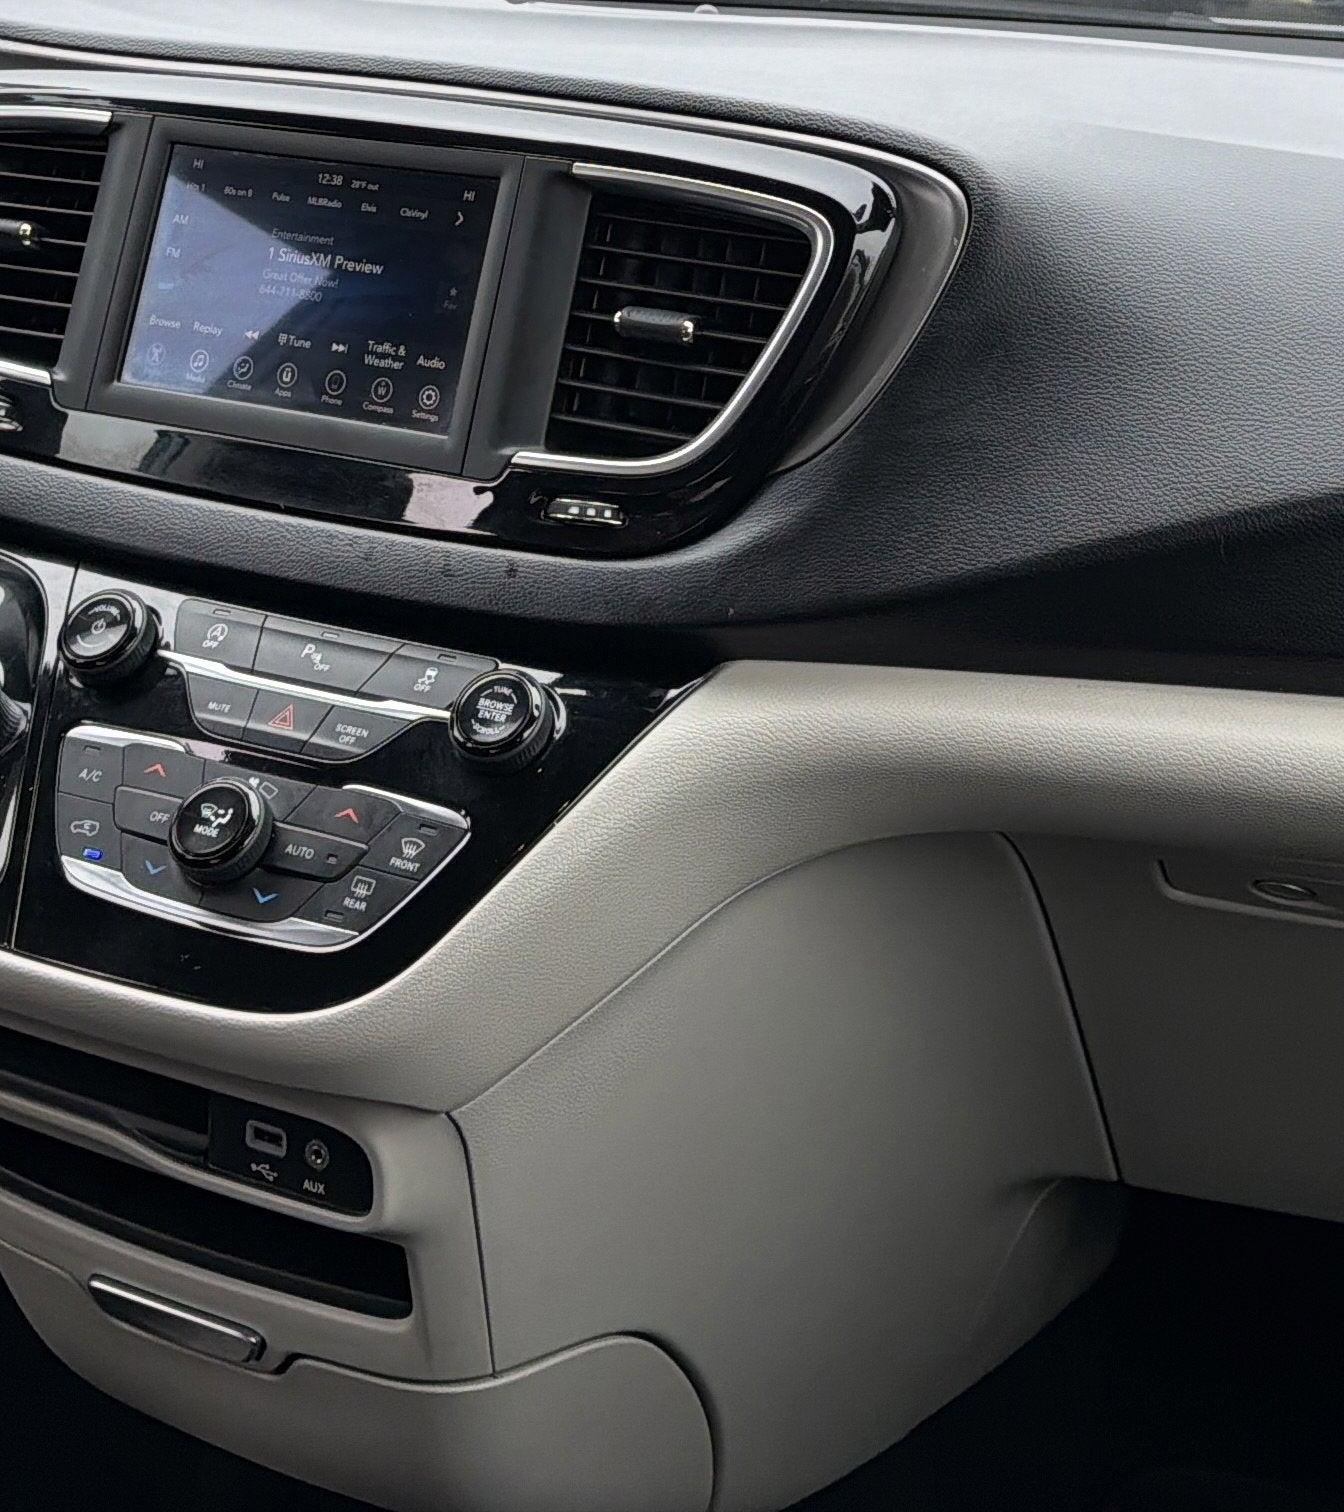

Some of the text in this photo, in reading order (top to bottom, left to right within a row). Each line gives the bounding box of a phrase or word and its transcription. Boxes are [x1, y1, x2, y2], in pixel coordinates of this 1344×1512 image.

[318, 173, 343, 186] 12:38
[463, 190, 475, 201] HI
[272, 228, 335, 246] Entertainment
[278, 248, 332, 268] SiriusXM
[334, 255, 384, 275] Preview
[149, 314, 181, 330] Browse
[193, 321, 223, 338] Replay
[288, 336, 311, 350] Tune
[367, 339, 406, 356] Traffic &
[364, 352, 404, 370] Weather
[416, 355, 446, 370] Audio
[321, 394, 343, 407] Phone
[362, 400, 394, 415] Compass
[202, 639, 219, 649] OFF
[313, 663, 330, 672] OFF
[413, 683, 431, 693] OFF
[207, 701, 231, 713] MUTE
[477, 697, 515, 713] BROWSE
[478, 709, 507, 723] ENTER
[335, 723, 369, 738] SCREEN
[338, 734, 357, 745] OFF
[78, 768, 103, 783] A/C
[150, 811, 170, 824] OFF
[194, 824, 219, 838] MODE
[285, 844, 315, 860] AUTO
[389, 856, 421, 872] FRONT
[343, 897, 367, 912] REAR
[303, 1179, 325, 1195] AUX
